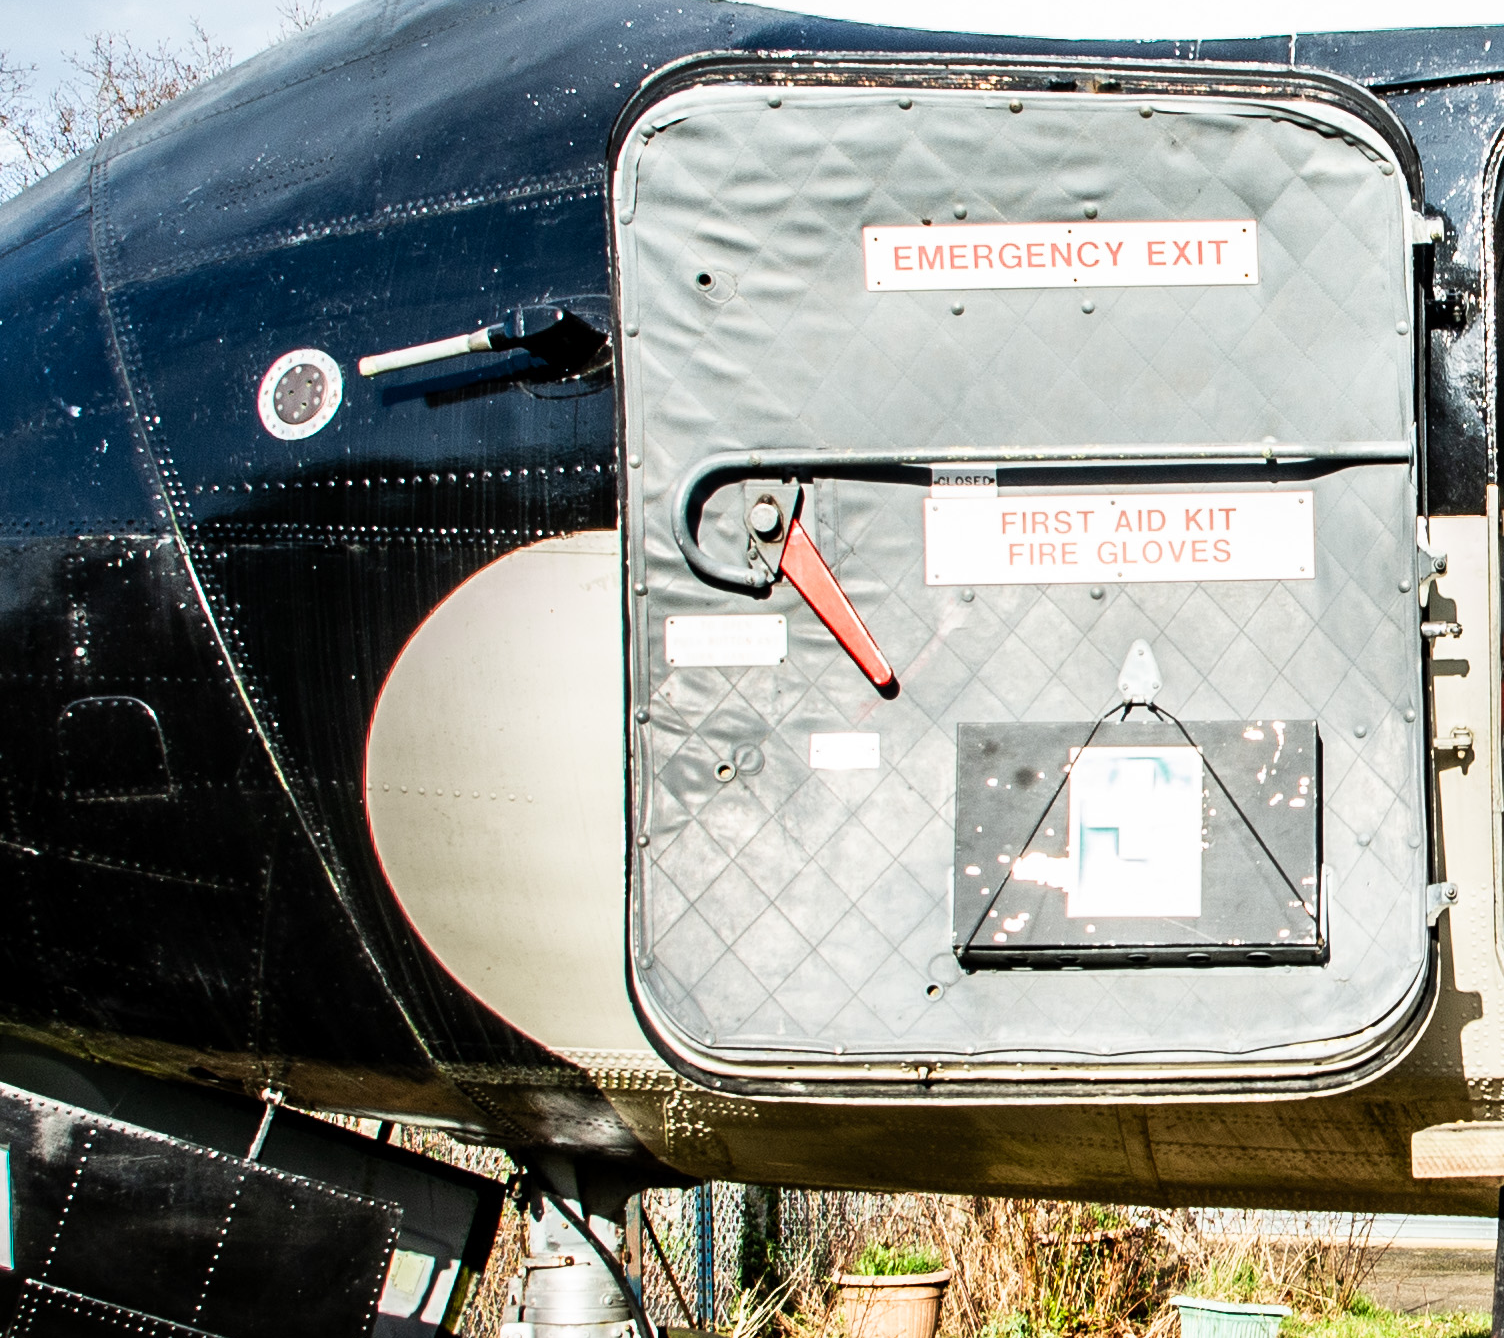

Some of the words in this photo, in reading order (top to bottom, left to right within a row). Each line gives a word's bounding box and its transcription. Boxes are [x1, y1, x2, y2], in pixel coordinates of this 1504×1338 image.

[893, 241, 1124, 271] EMERGENCY
[1147, 240, 1229, 266] EXIT
[937, 475, 991, 486] CLOSED
[1001, 510, 1095, 534] FIRST
[1114, 509, 1166, 533] AID
[1185, 508, 1237, 532] KIT
[1009, 542, 1078, 566] FIRE
[1097, 539, 1232, 565] GLOVES
